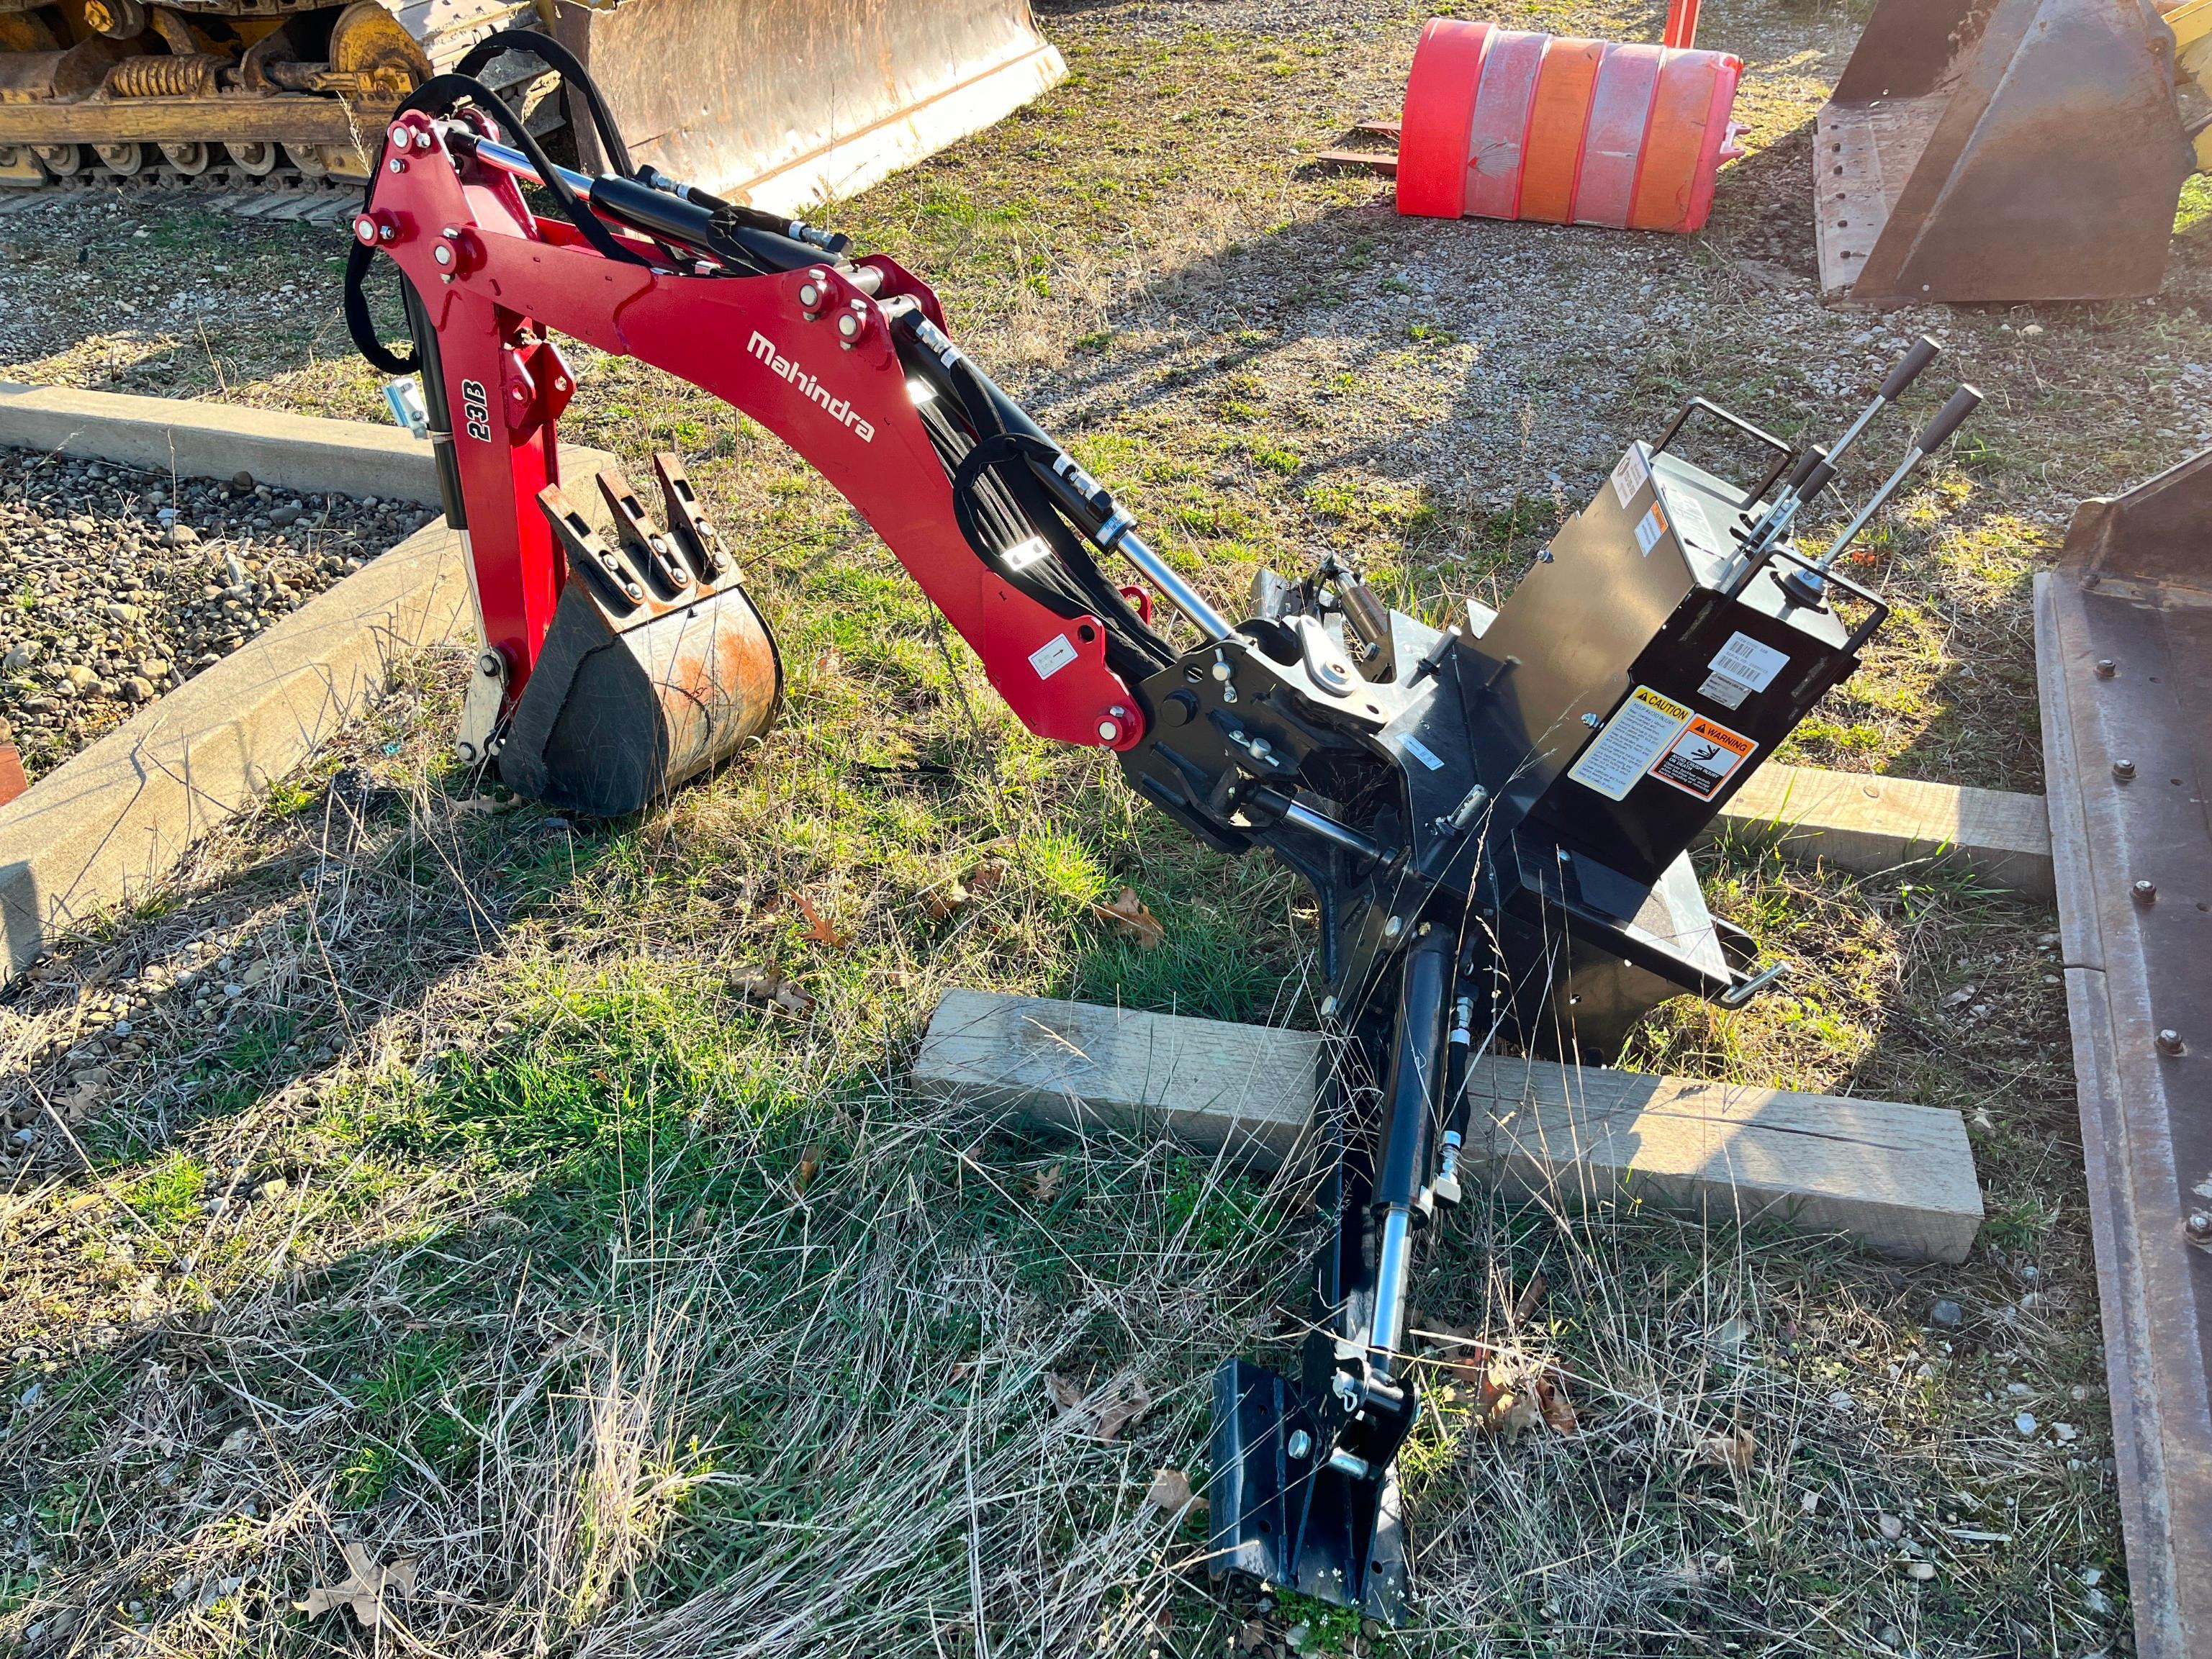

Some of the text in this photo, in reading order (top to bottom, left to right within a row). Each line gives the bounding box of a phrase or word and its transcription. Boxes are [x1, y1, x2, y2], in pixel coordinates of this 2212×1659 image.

[747, 330, 875, 443] Mahindra
[461, 379, 492, 443] 23B
[1648, 696, 1689, 720] CAUTION
[1707, 728, 1747, 751] WARNING
[1671, 754, 1719, 779] AVOID CRUSH INJURY
[1676, 761, 1692, 771] DEATH
